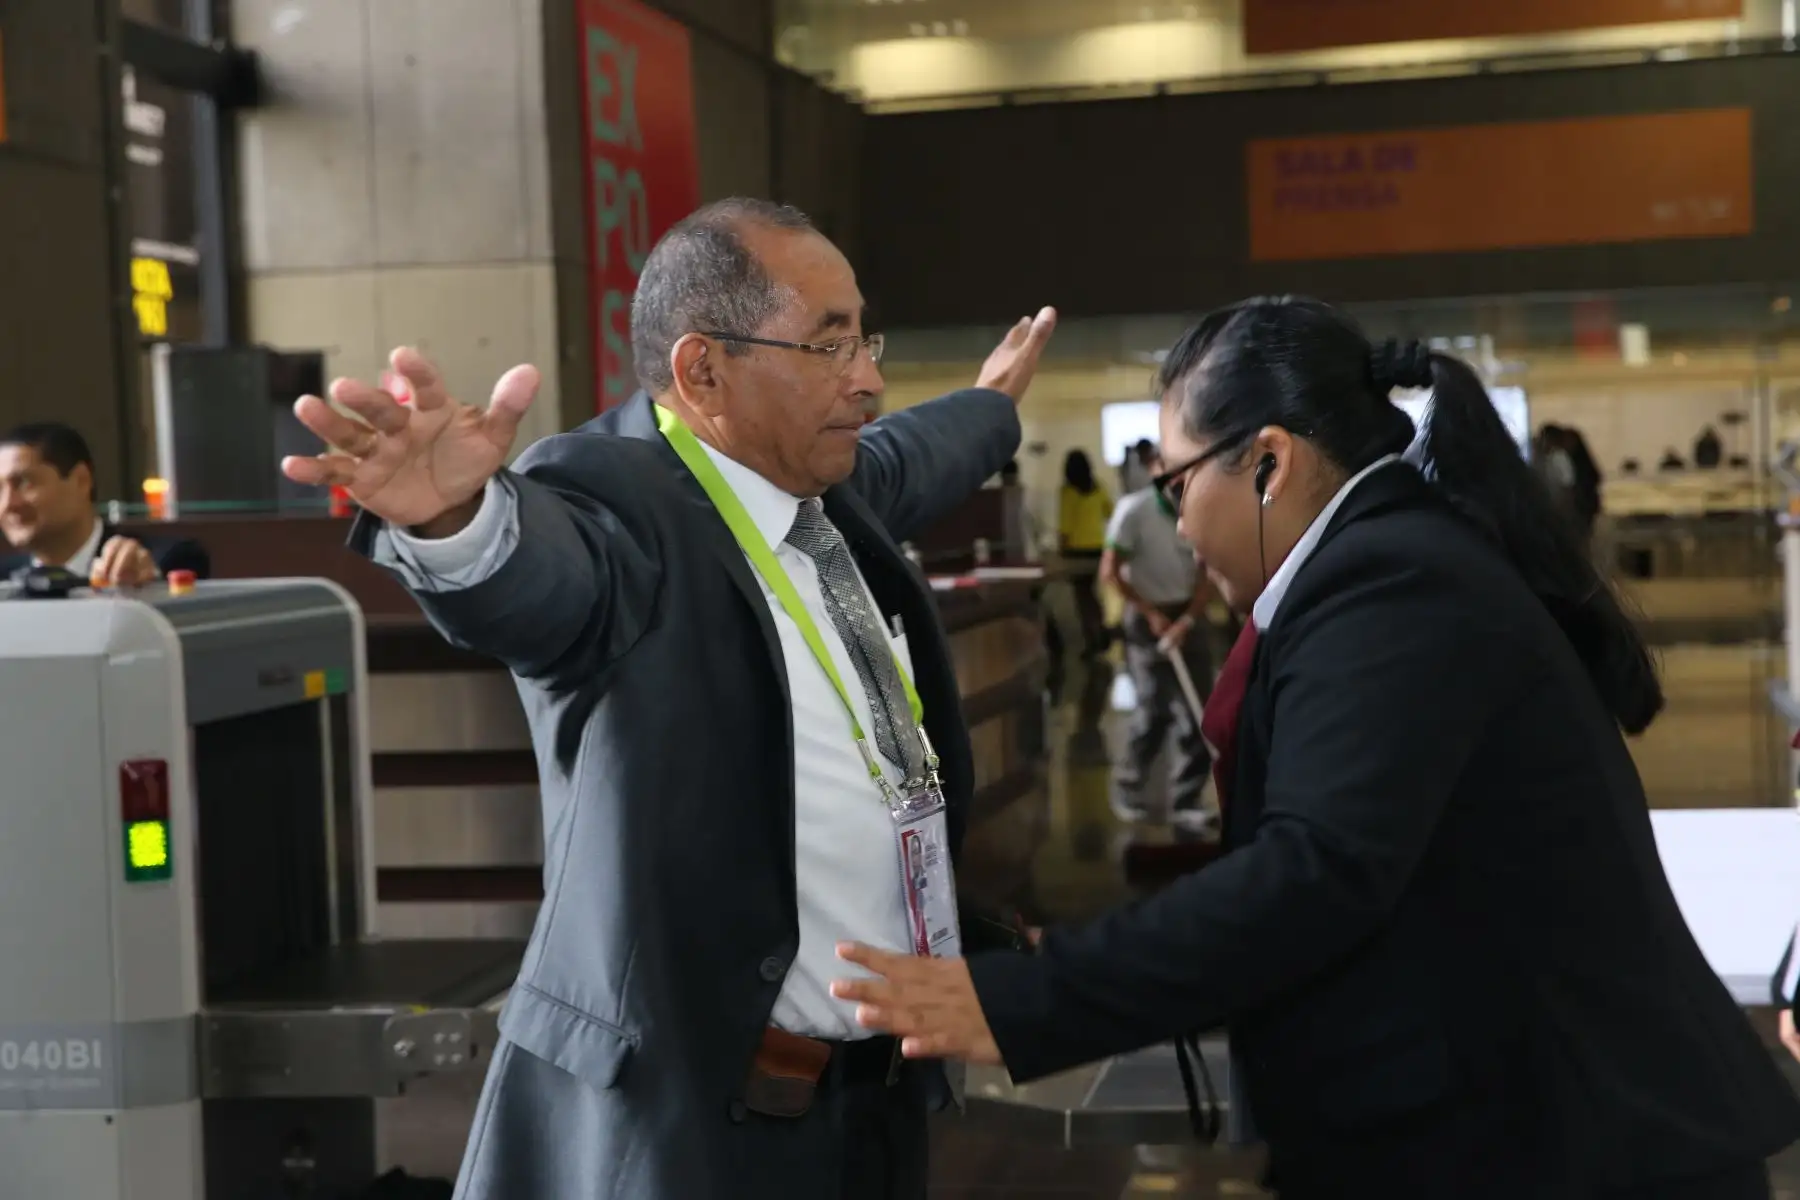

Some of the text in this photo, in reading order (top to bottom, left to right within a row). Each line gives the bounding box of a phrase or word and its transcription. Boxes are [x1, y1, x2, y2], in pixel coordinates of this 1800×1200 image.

[587, 27, 642, 153] EX
[594, 157, 649, 276] PO
[1274, 143, 1416, 178] SALA DE
